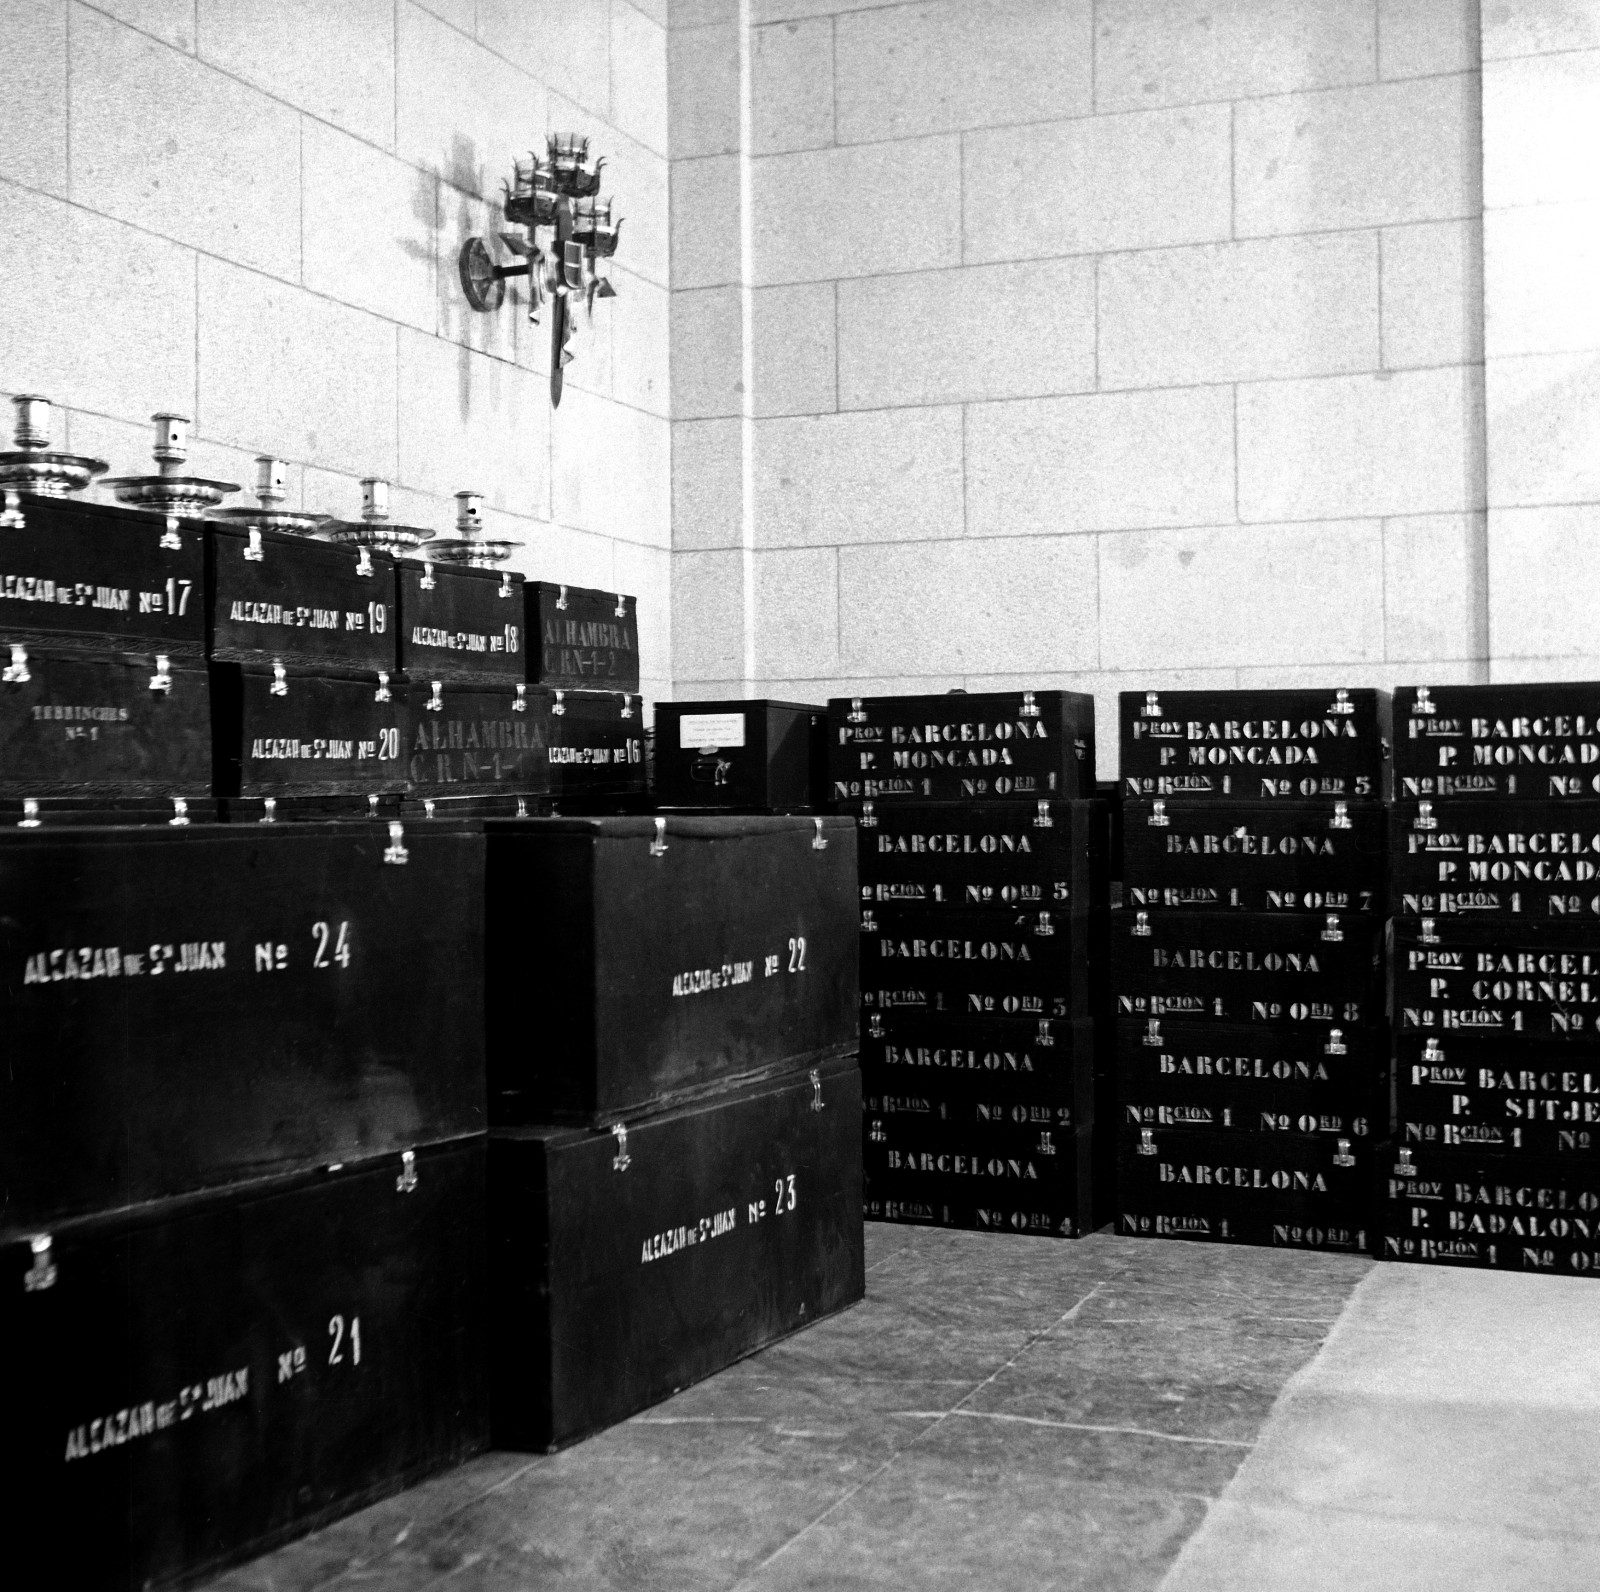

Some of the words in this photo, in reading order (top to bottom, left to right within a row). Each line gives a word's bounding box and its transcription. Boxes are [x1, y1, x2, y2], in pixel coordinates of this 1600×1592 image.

[92, 586, 131, 611] JUAN
[165, 577, 192, 616] 17
[230, 600, 282, 624] ALCAZAR
[309, 608, 339, 629] JUAN
[368, 601, 388, 634] 19
[412, 626, 448, 646] ALCAZAR
[467, 633, 487, 652] JUAN
[504, 623, 519, 653] 18
[543, 620, 631, 650] ALHAMBRA
[413, 720, 545, 750] ALHAMBRA
[891, 720, 1049, 744] BARCELONA
[1187, 718, 1358, 740] BARCELONA
[1471, 715, 1600, 738] BARCEL
[252, 738, 299, 760] ALCAZAR
[326, 740, 354, 760] JUAN
[379, 727, 400, 761] 20
[592, 748, 611, 763] JUAN
[626, 738, 640, 764] 16
[1188, 745, 1319, 765] MONCADA
[893, 747, 1014, 769] MONCADA
[1048, 771, 1057, 790] 1
[1354, 775, 1372, 795] 5
[878, 834, 1032, 854] BARCELONA
[1167, 834, 1335, 856] BARCELONA
[1053, 881, 1069, 900] 5
[1359, 891, 1373, 911] 7
[24, 946, 120, 985] ALCAZAR
[174, 941, 227, 973] JUAN
[312, 920, 350, 969] 24
[880, 939, 1031, 961] BARCELONA
[1153, 948, 1320, 973] BARCELONA
[672, 968, 712, 997] ALCAZAR
[731, 960, 754, 985] JUAN
[788, 937, 807, 973] 22
[1052, 997, 1067, 1016] 5
[1343, 1002, 1360, 1021] 8
[884, 1045, 1034, 1071] BARCELONA
[1160, 1054, 1330, 1081] BARCELONA
[1057, 1107, 1071, 1126] 2
[1352, 1116, 1370, 1136] 6
[888, 1149, 1038, 1180] BARCELONA
[1160, 1163, 1328, 1192] BARCELONA
[1455, 1182, 1599, 1212] BARCELO
[641, 1225, 687, 1264] ALCAZAR
[711, 1207, 737, 1239] JUAN
[775, 1174, 797, 1216] 23
[1059, 1216, 1073, 1235] 4
[1356, 1229, 1367, 1250] 1
[64, 1401, 155, 1463] ALCAZAR
[202, 1364, 249, 1412] JUAN
[328, 1314, 361, 1367] 21
